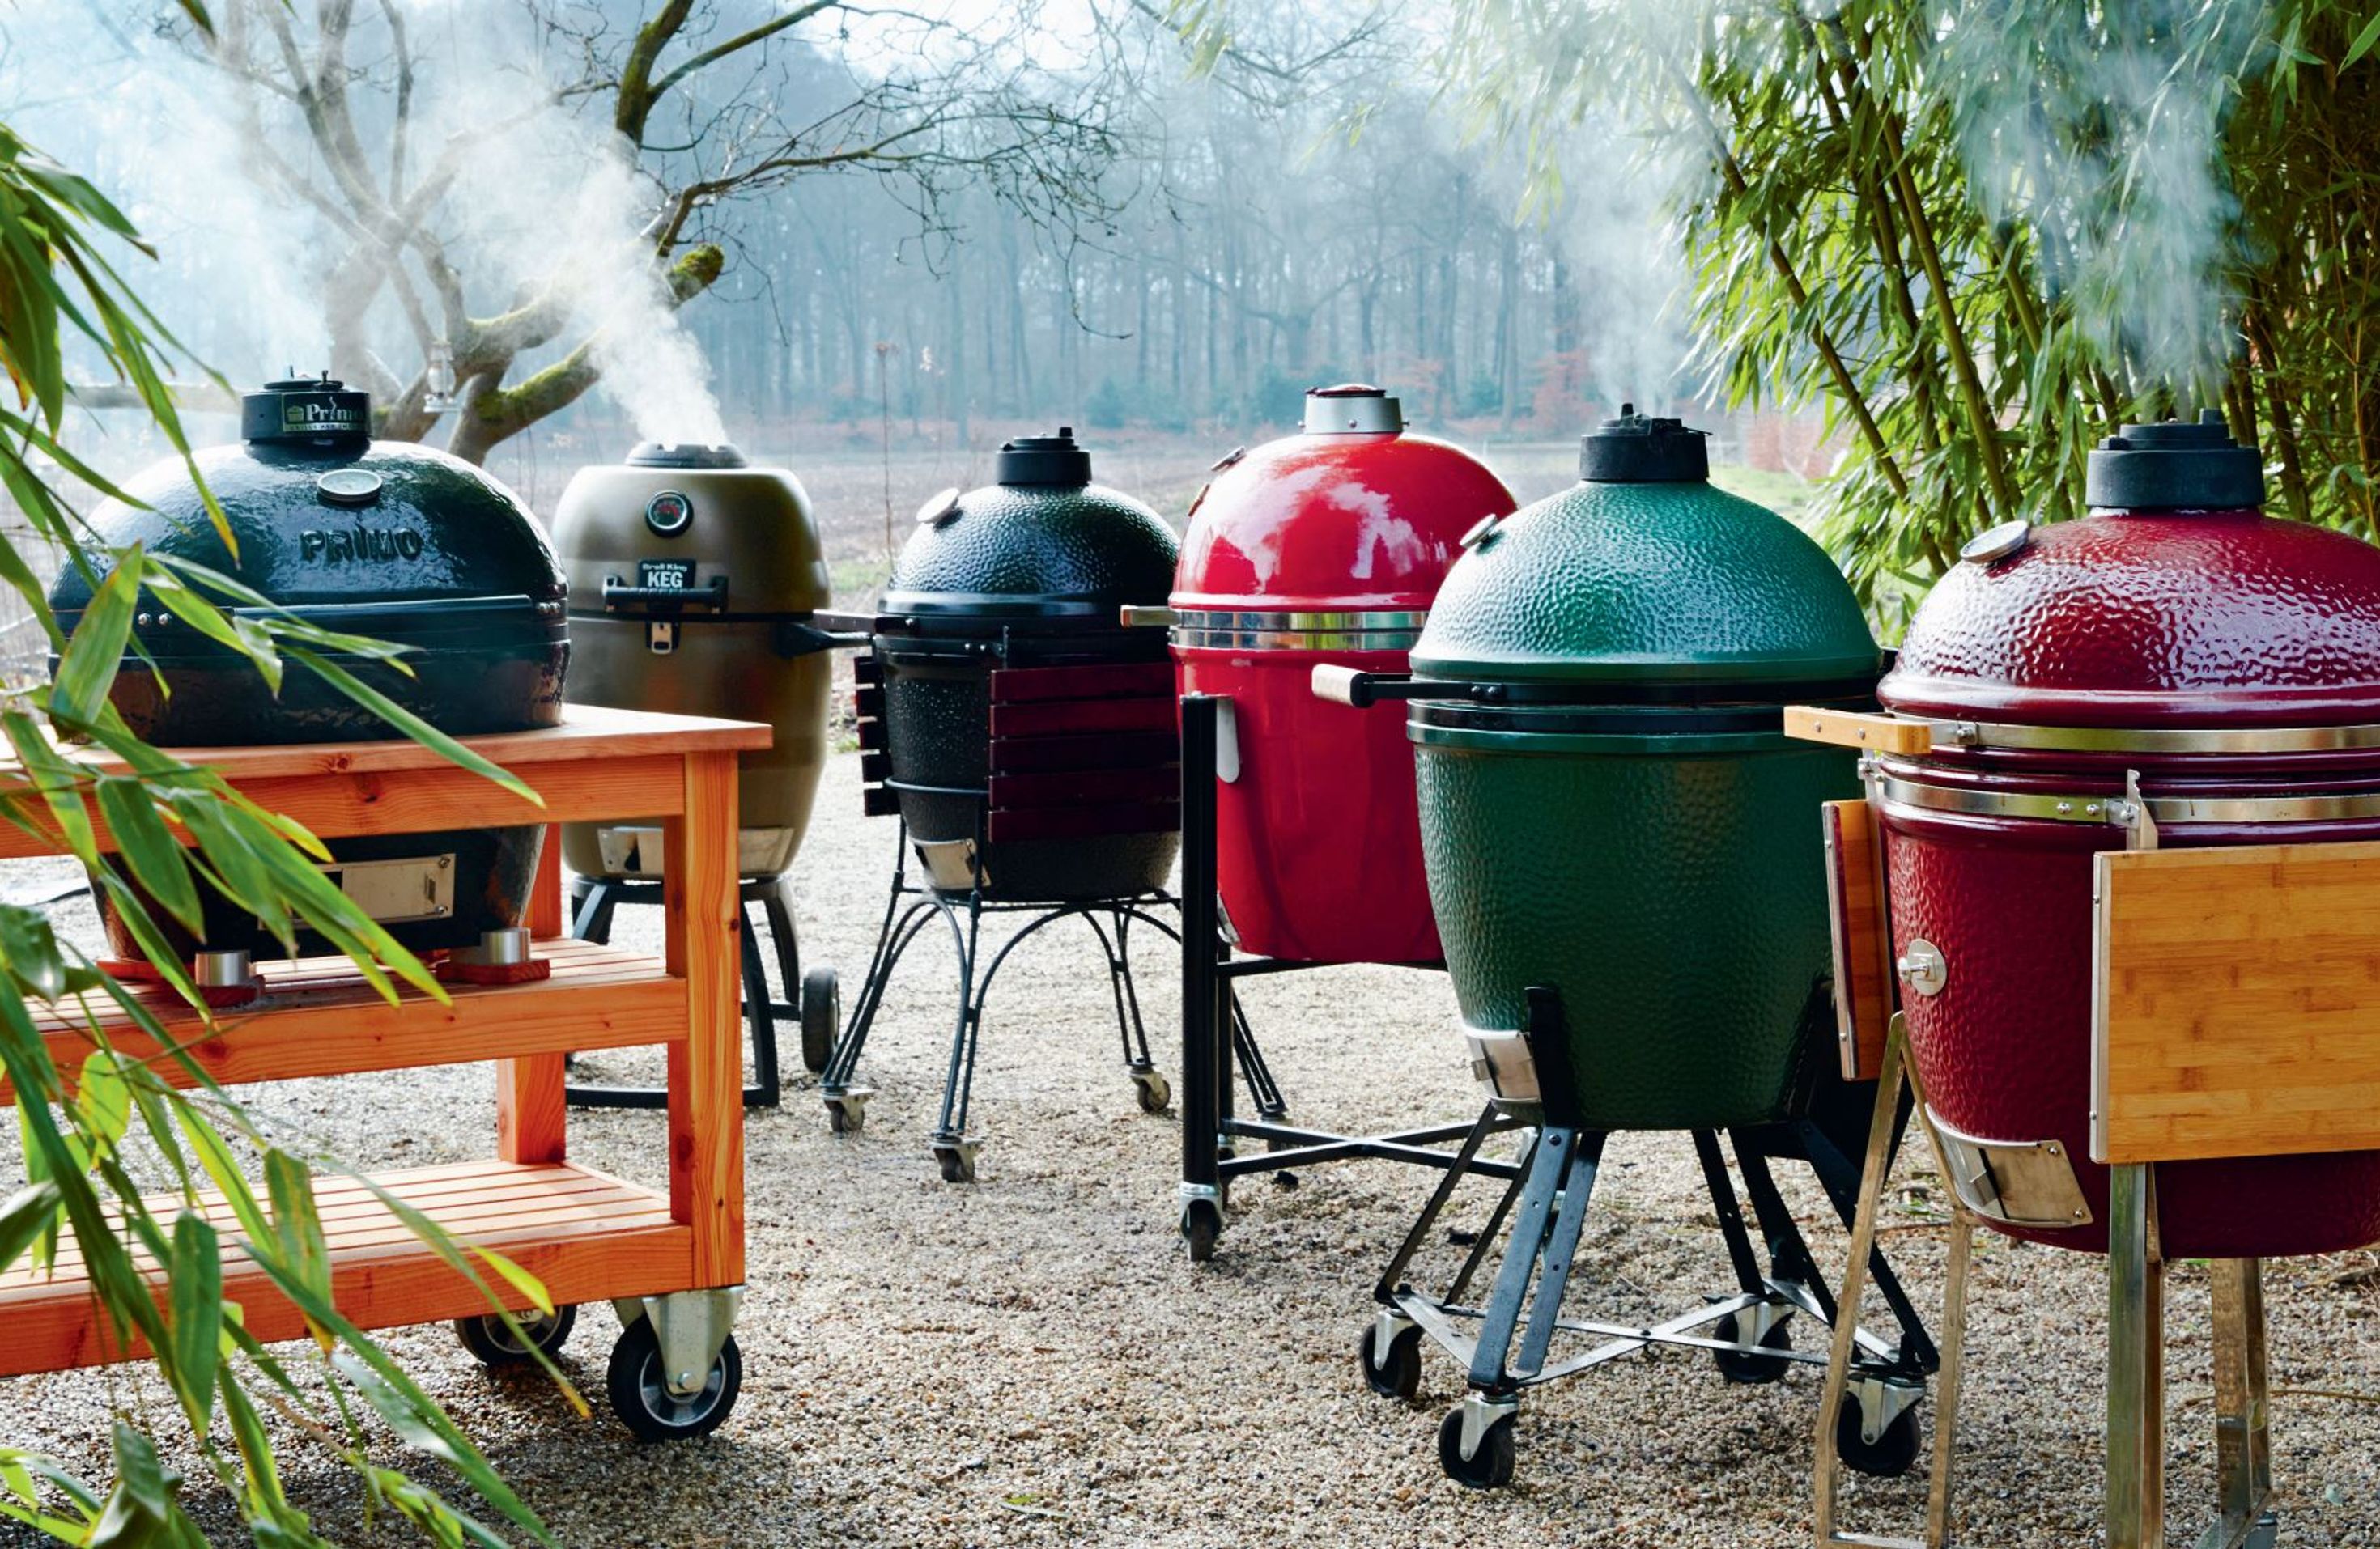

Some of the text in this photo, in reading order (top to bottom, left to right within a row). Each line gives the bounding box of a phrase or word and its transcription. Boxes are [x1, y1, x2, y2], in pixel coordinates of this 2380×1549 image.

[299, 527, 424, 562] PRIMO
[666, 563, 687, 572] King
[648, 571, 683, 588] KEG
